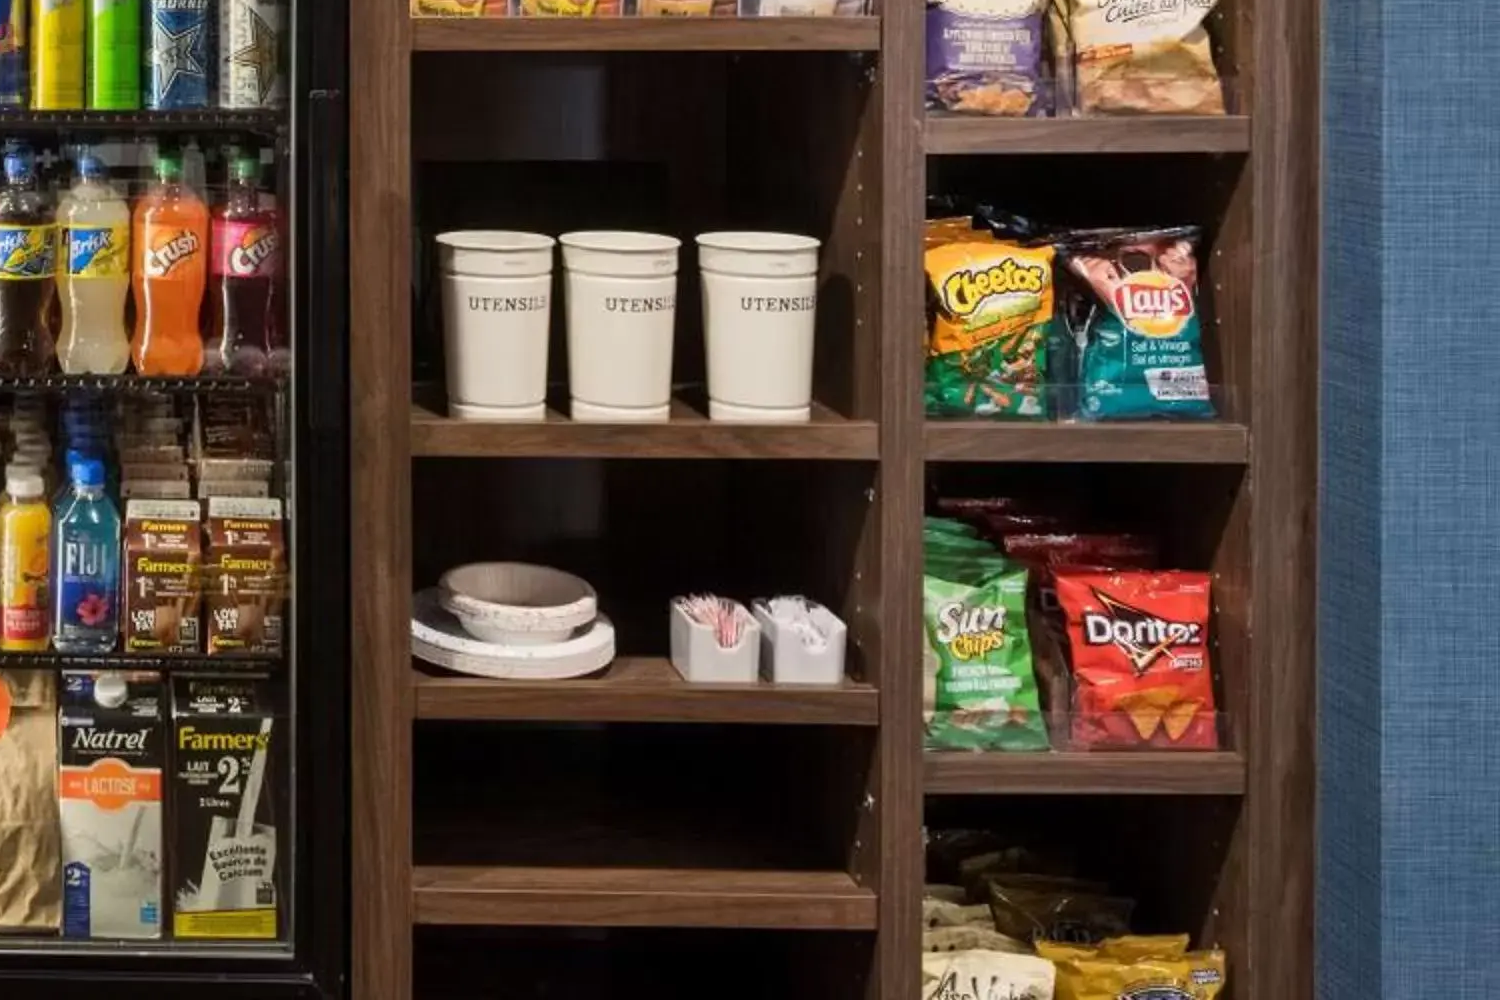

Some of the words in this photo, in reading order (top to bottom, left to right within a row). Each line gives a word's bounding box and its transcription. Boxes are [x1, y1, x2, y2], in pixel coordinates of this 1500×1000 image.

[145, 231, 198, 276] Crush
[944, 259, 1042, 314] Cheetos
[1123, 283, 1185, 320] Lay's
[137, 557, 193, 574] Farmers
[221, 553, 276, 571] Farmers
[937, 602, 1007, 642] Sun
[1085, 615, 1201, 644] Doritos
[951, 631, 1004, 661] Chips
[72, 727, 149, 750] Natrel
[180, 726, 267, 750] Farmers
[187, 761, 209, 772] LAIT
[217, 756, 240, 794] 2
